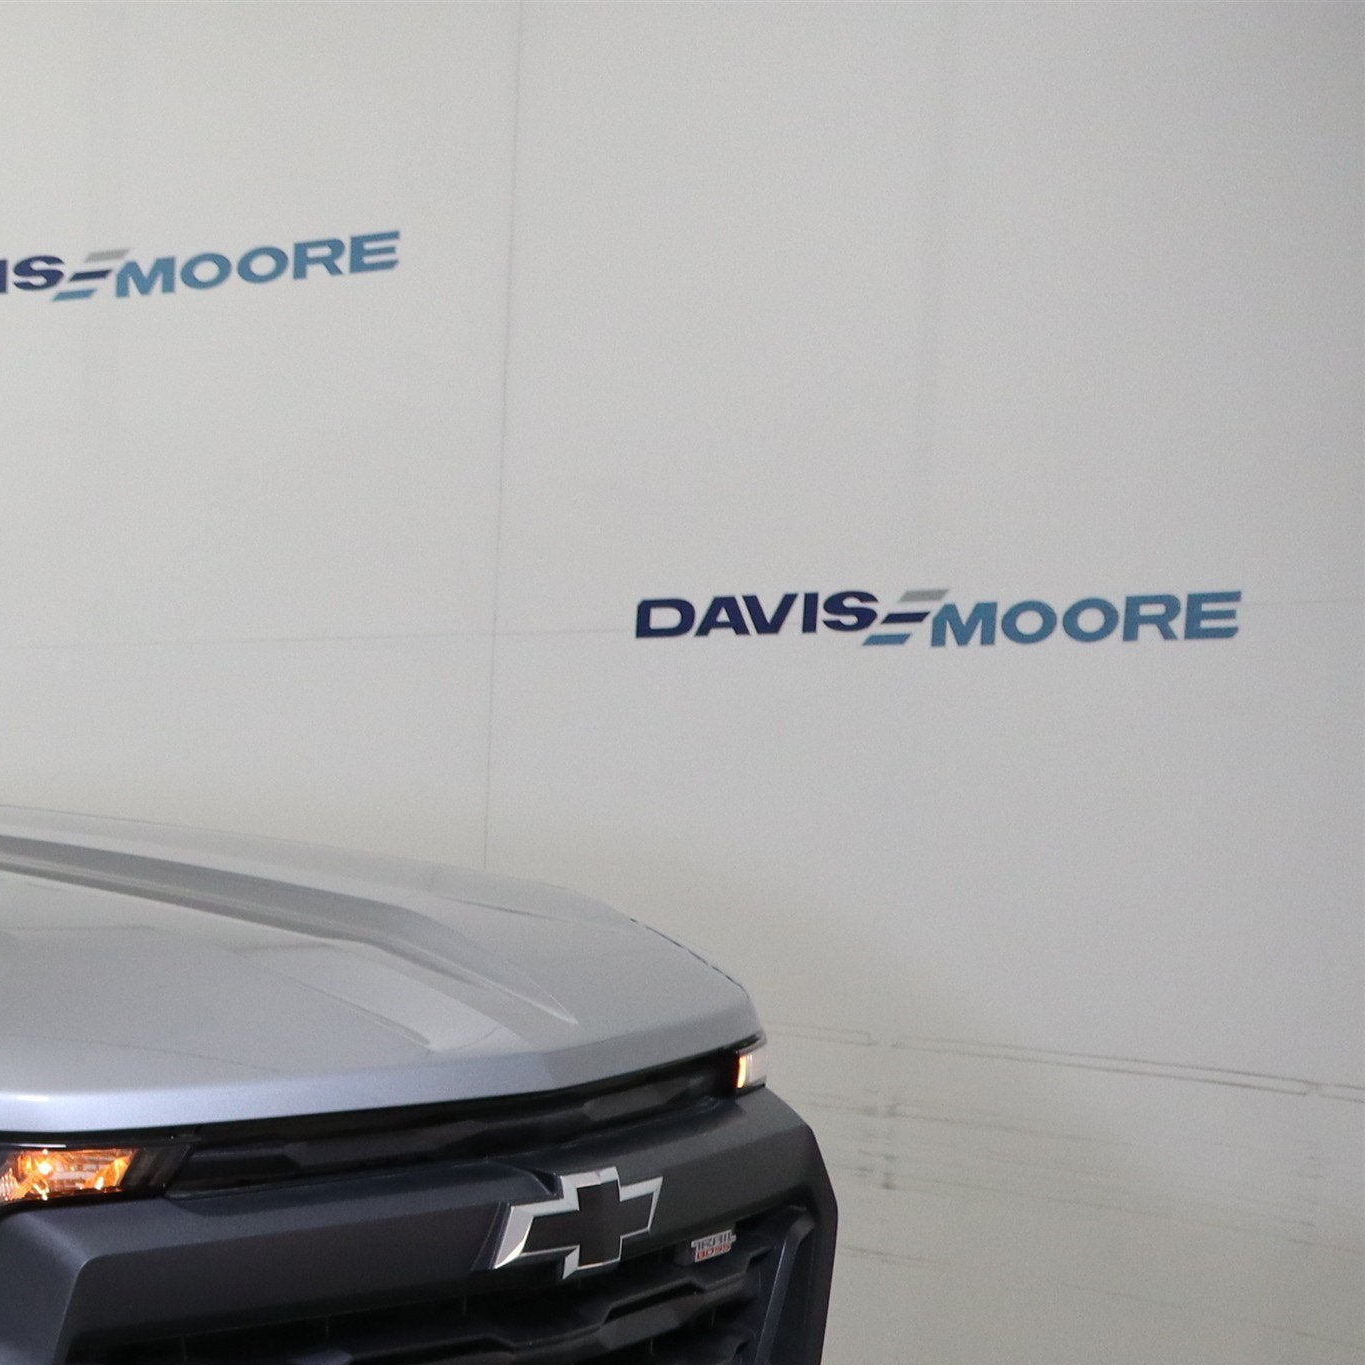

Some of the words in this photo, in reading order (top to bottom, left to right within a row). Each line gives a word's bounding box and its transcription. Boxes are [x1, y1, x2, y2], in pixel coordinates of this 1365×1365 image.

[114, 230, 402, 299] MOORE
[635, 589, 879, 639] DAVIS
[929, 590, 1243, 648] MOORE
